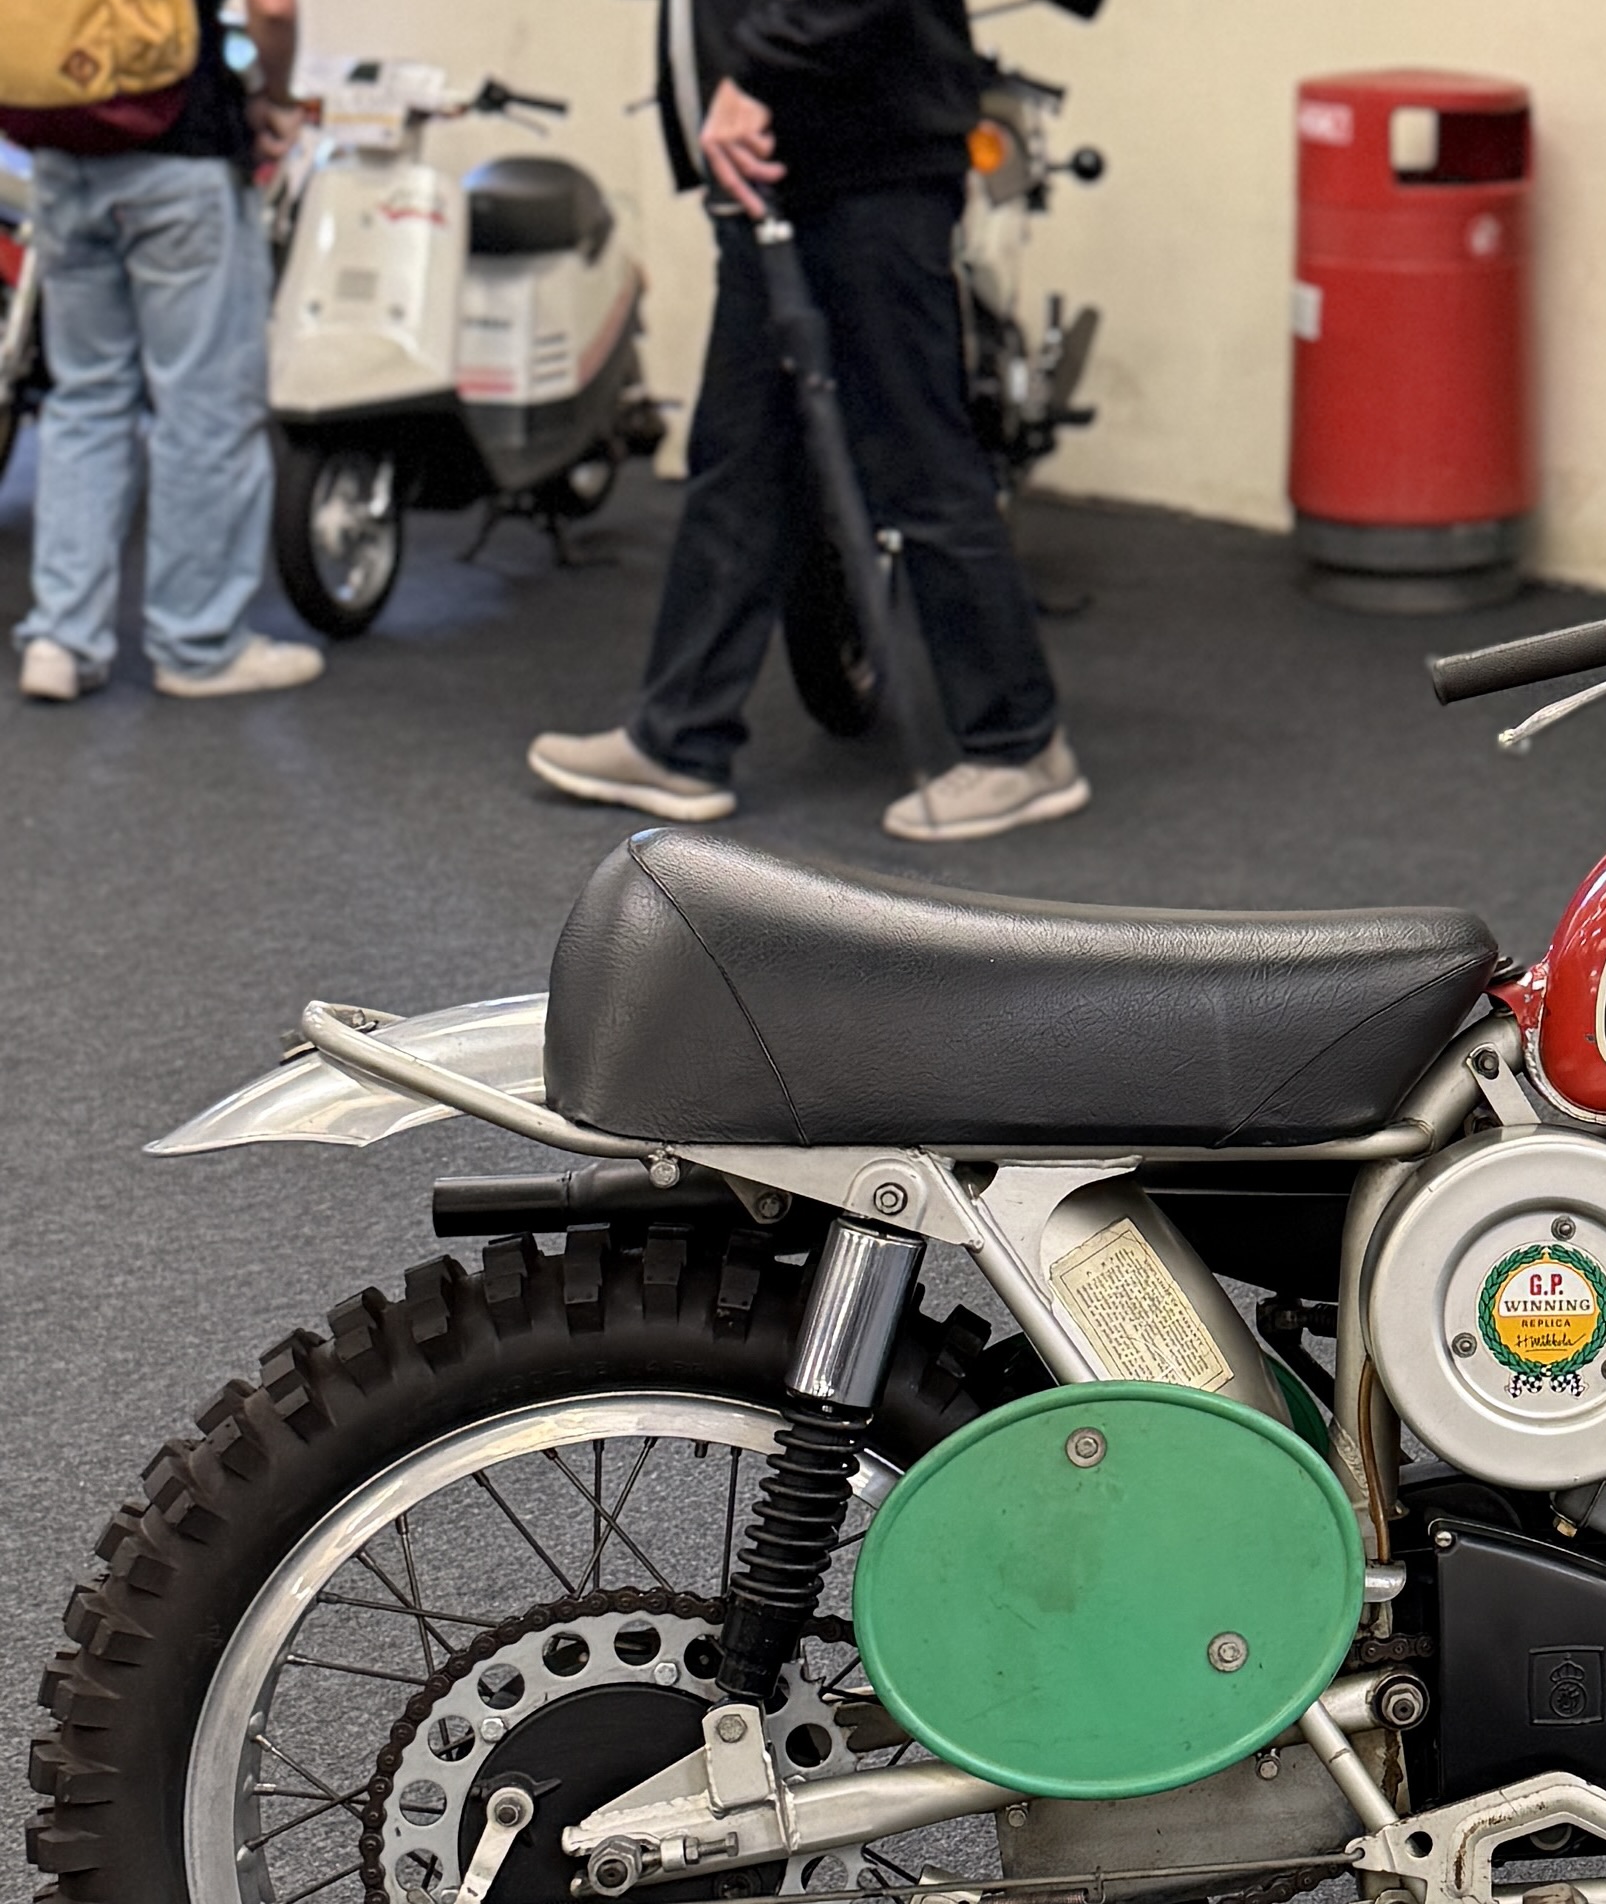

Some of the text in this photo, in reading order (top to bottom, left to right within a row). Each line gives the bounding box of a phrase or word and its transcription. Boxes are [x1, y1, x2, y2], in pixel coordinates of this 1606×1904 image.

[1529, 1273, 1564, 1296] G.P.
[1504, 1299, 1591, 1313] WINNING
[1521, 1318, 1571, 1328] REPLICA
